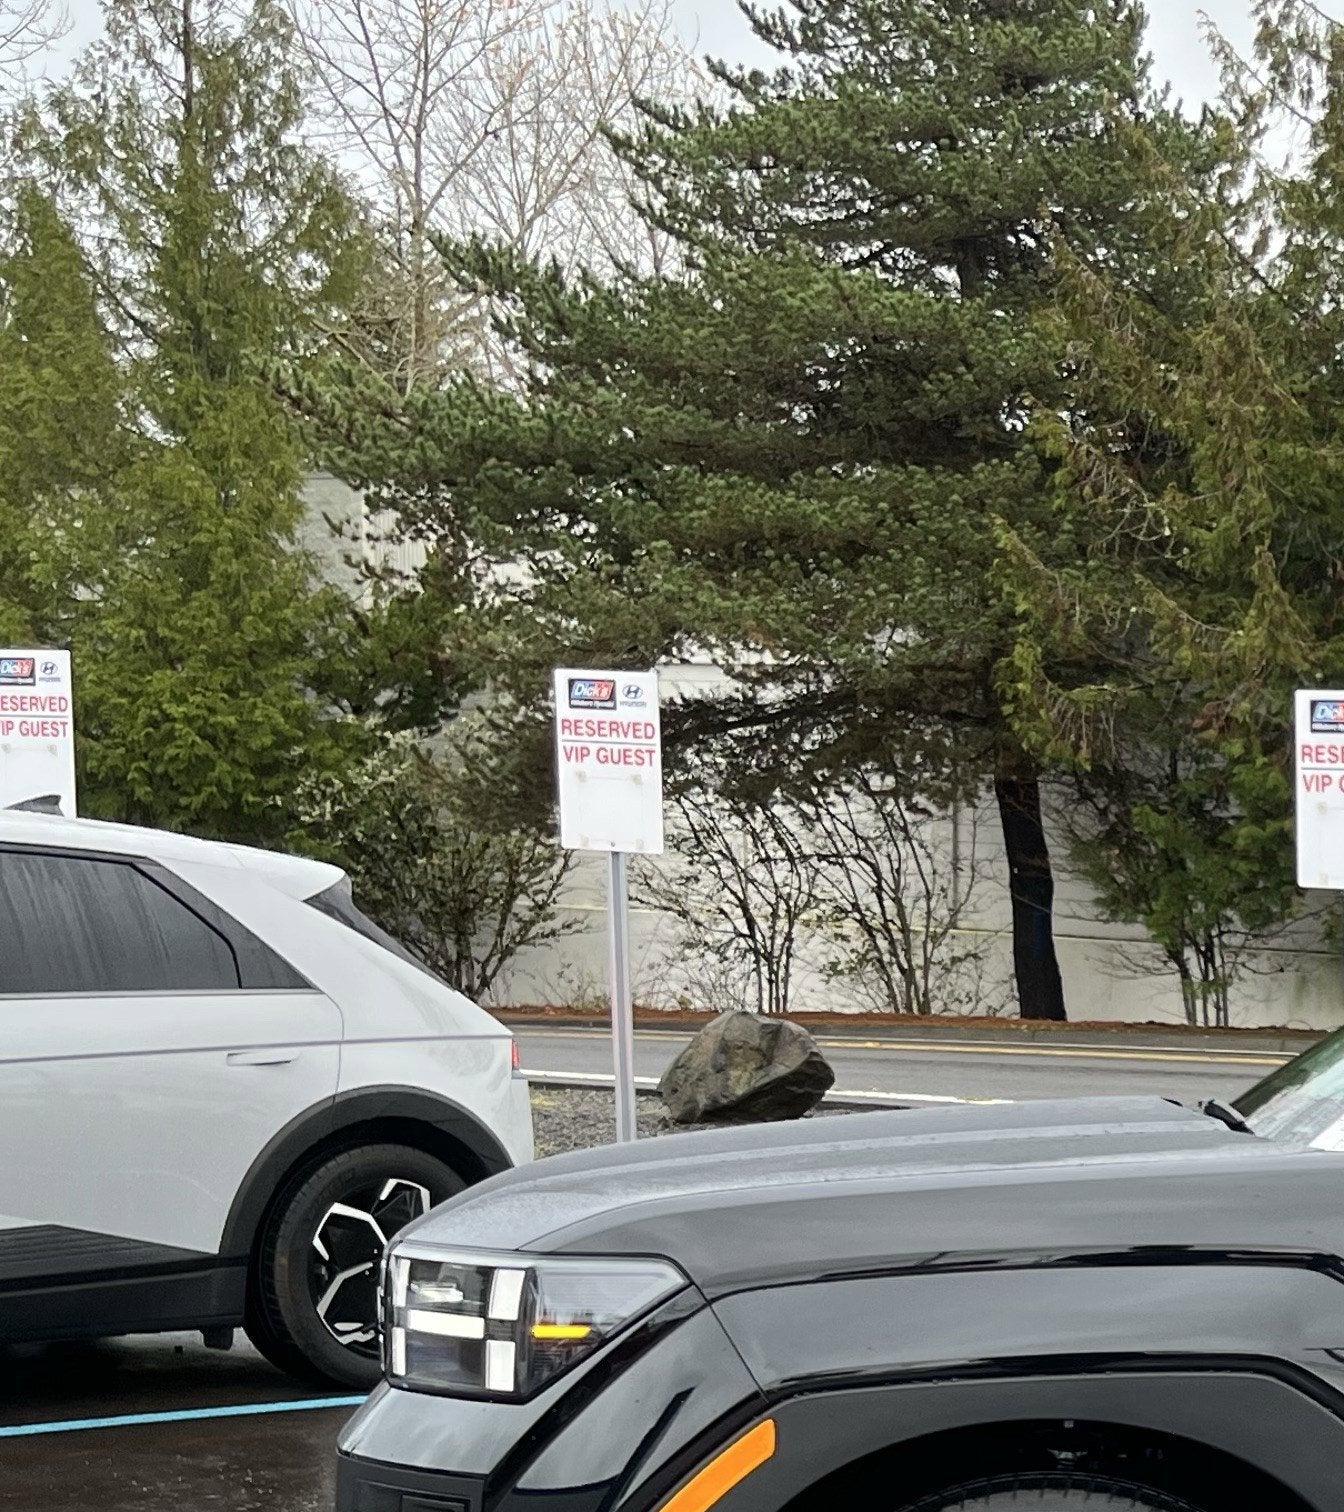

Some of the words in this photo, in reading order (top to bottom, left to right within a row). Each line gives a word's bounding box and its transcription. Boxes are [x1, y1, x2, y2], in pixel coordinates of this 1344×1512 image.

[0, 695, 68, 712] ESERVED
[0, 720, 14, 736] IP
[19, 720, 68, 738] GUEST
[561, 718, 655, 739] RESERVED
[563, 745, 590, 763] VIP
[596, 747, 656, 767] GUEST
[1302, 774, 1332, 793] VIP
